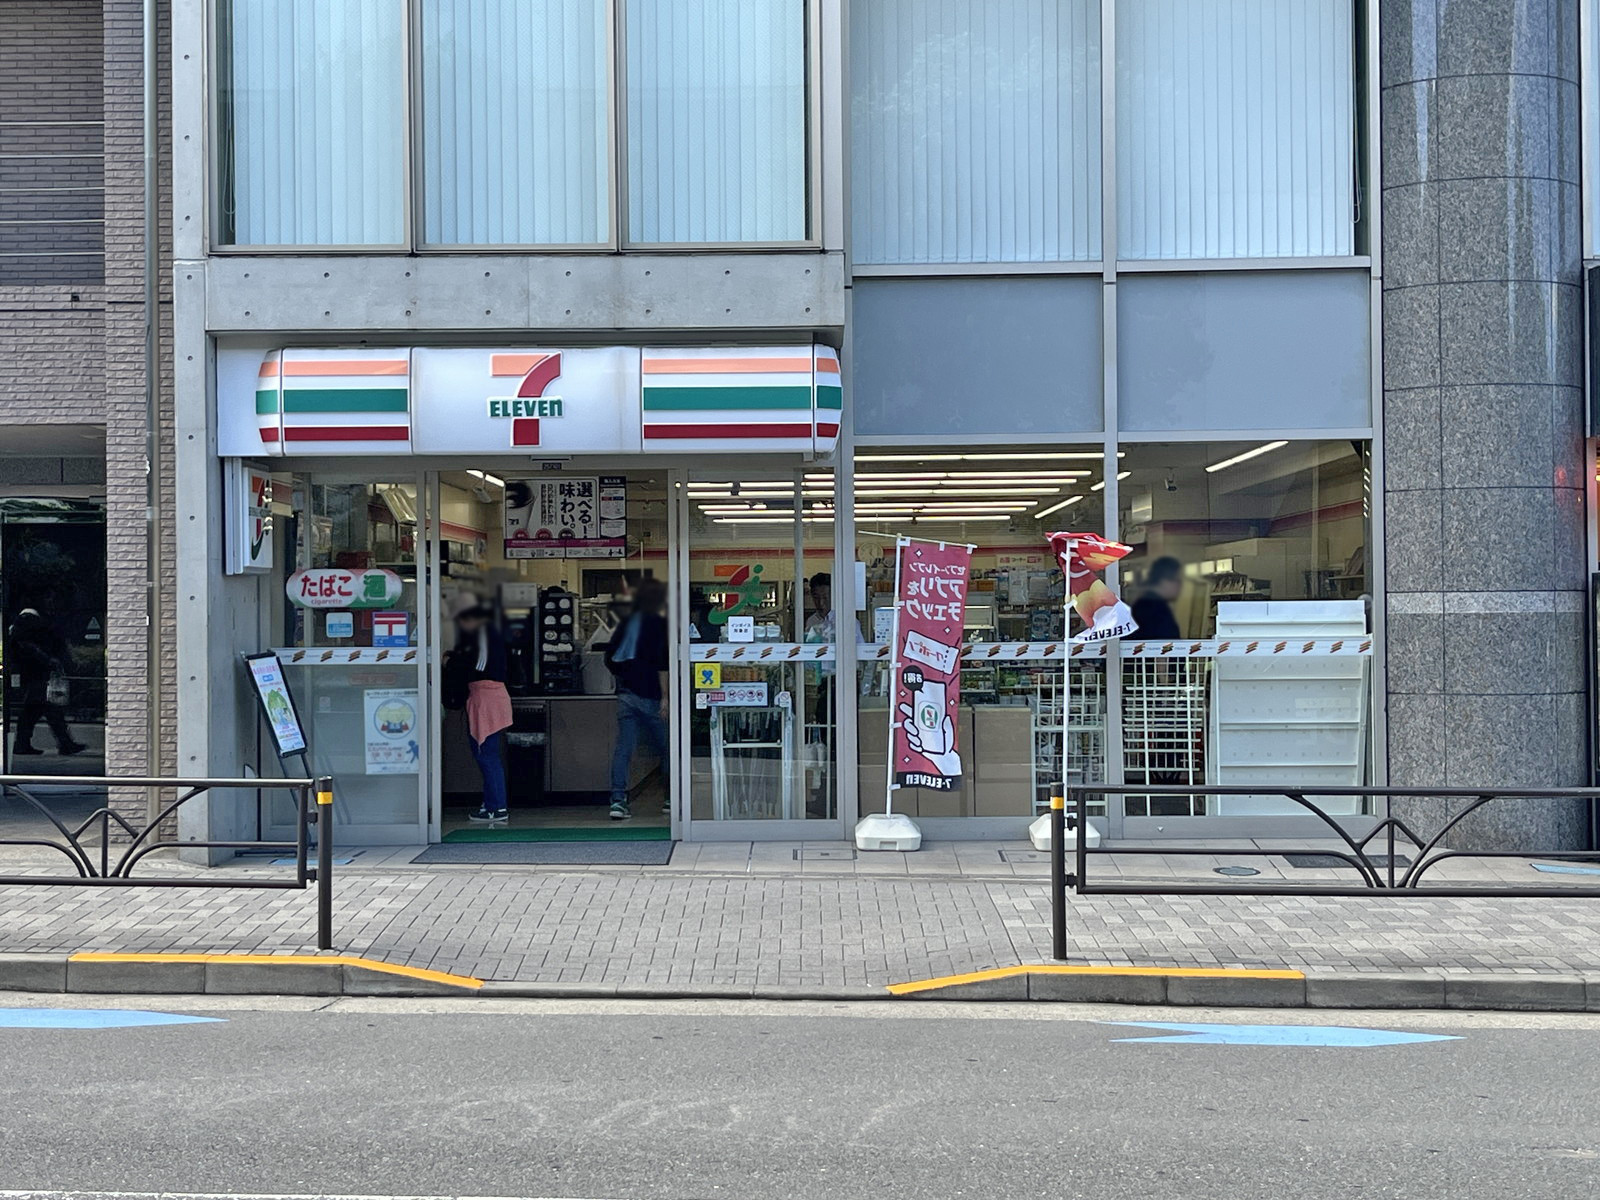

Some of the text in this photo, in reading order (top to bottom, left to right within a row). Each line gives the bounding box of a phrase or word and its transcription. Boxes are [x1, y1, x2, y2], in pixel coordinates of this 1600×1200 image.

[559, 482, 576, 529] 味わい。
[301, 574, 353, 597] たばこ
[363, 574, 387, 598] 酒
[311, 598, 343, 606] cigarette
